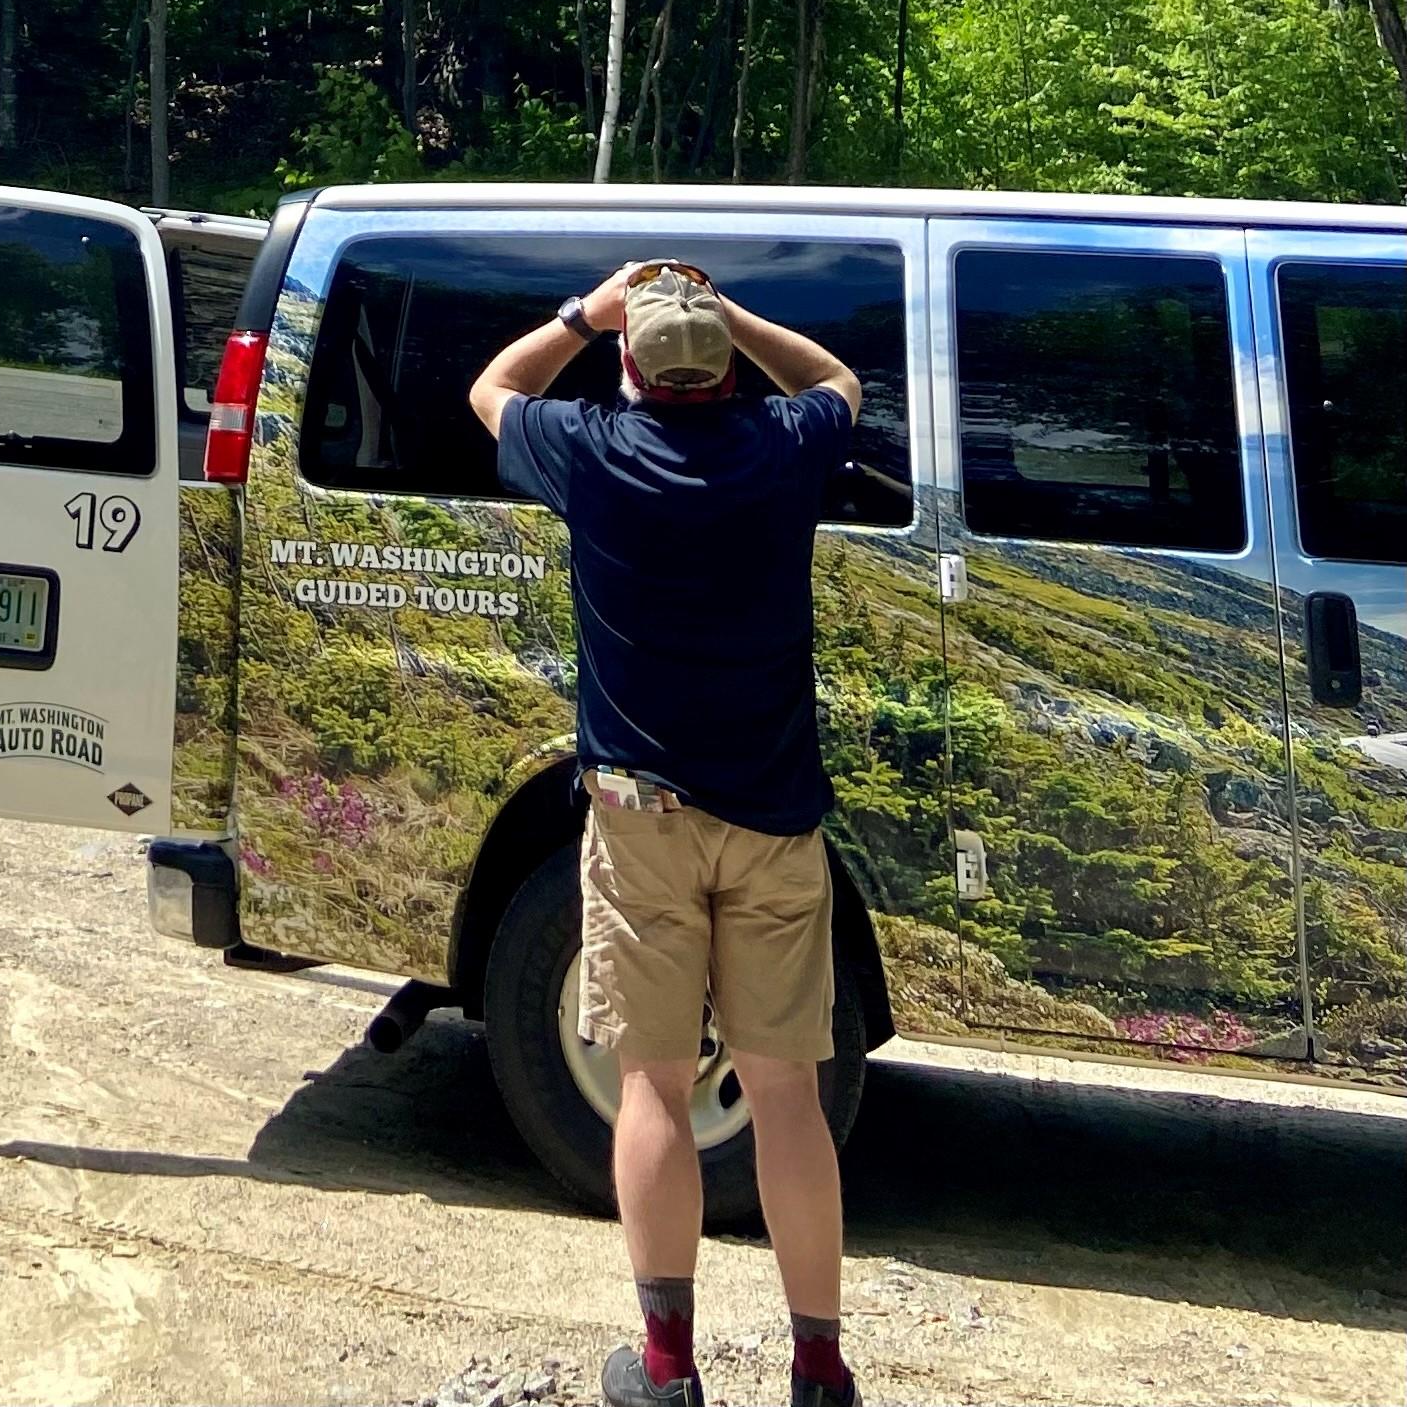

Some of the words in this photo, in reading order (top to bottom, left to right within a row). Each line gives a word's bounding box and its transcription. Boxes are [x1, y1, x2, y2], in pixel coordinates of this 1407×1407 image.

[64, 491, 141, 553] 19
[270, 539, 323, 565] MT.
[330, 542, 546, 580] WASHINGTON
[295, 578, 407, 608] GUIDED
[414, 585, 519, 617] TOURS
[19, 707, 104, 740] WASHINGTON
[50, 728, 103, 766] ROAD
